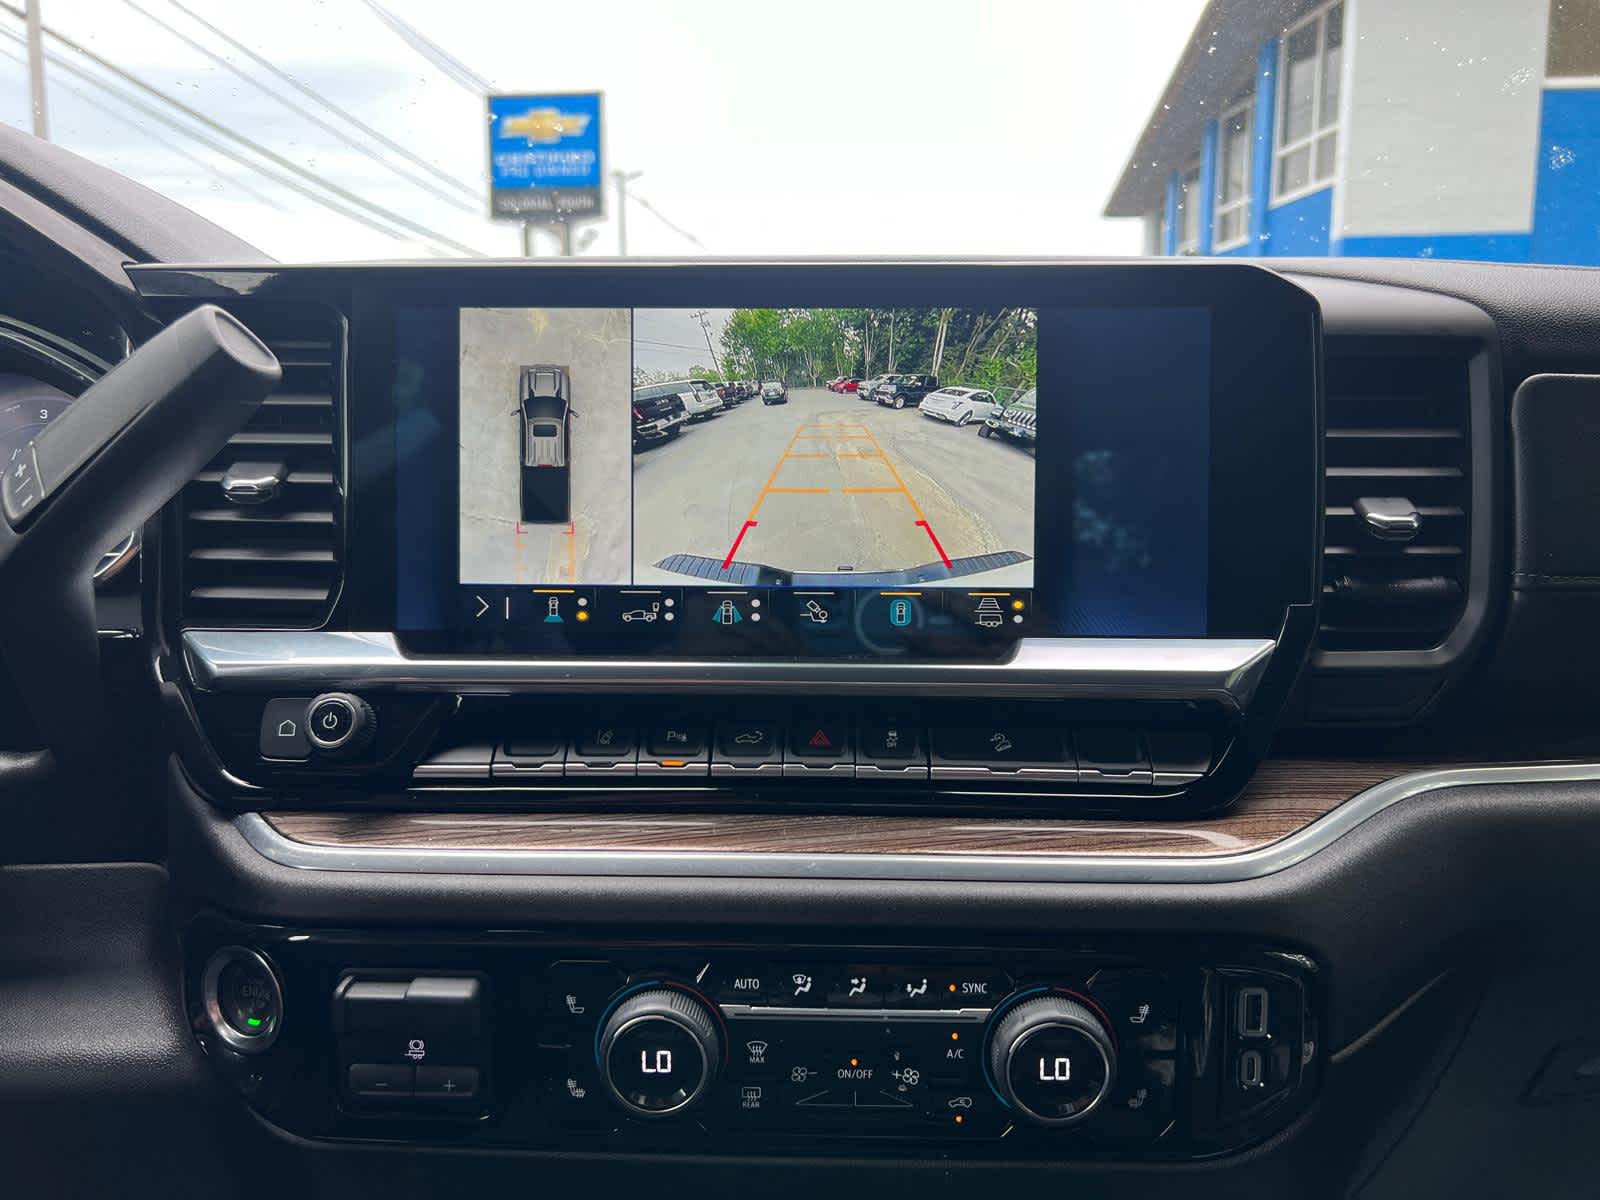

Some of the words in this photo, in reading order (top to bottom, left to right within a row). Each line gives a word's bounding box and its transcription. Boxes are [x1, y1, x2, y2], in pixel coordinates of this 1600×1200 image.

[39, 409, 48, 419] 3
[734, 978, 760, 990] AUTO
[962, 981, 988, 994] SYNC
[749, 1056, 766, 1064] MAX
[946, 1048, 964, 1060] A/C
[641, 1050, 672, 1073] LO
[837, 1068, 873, 1080] ON/OFF
[1039, 1057, 1071, 1081] LO
[742, 1100, 760, 1108] REAR
